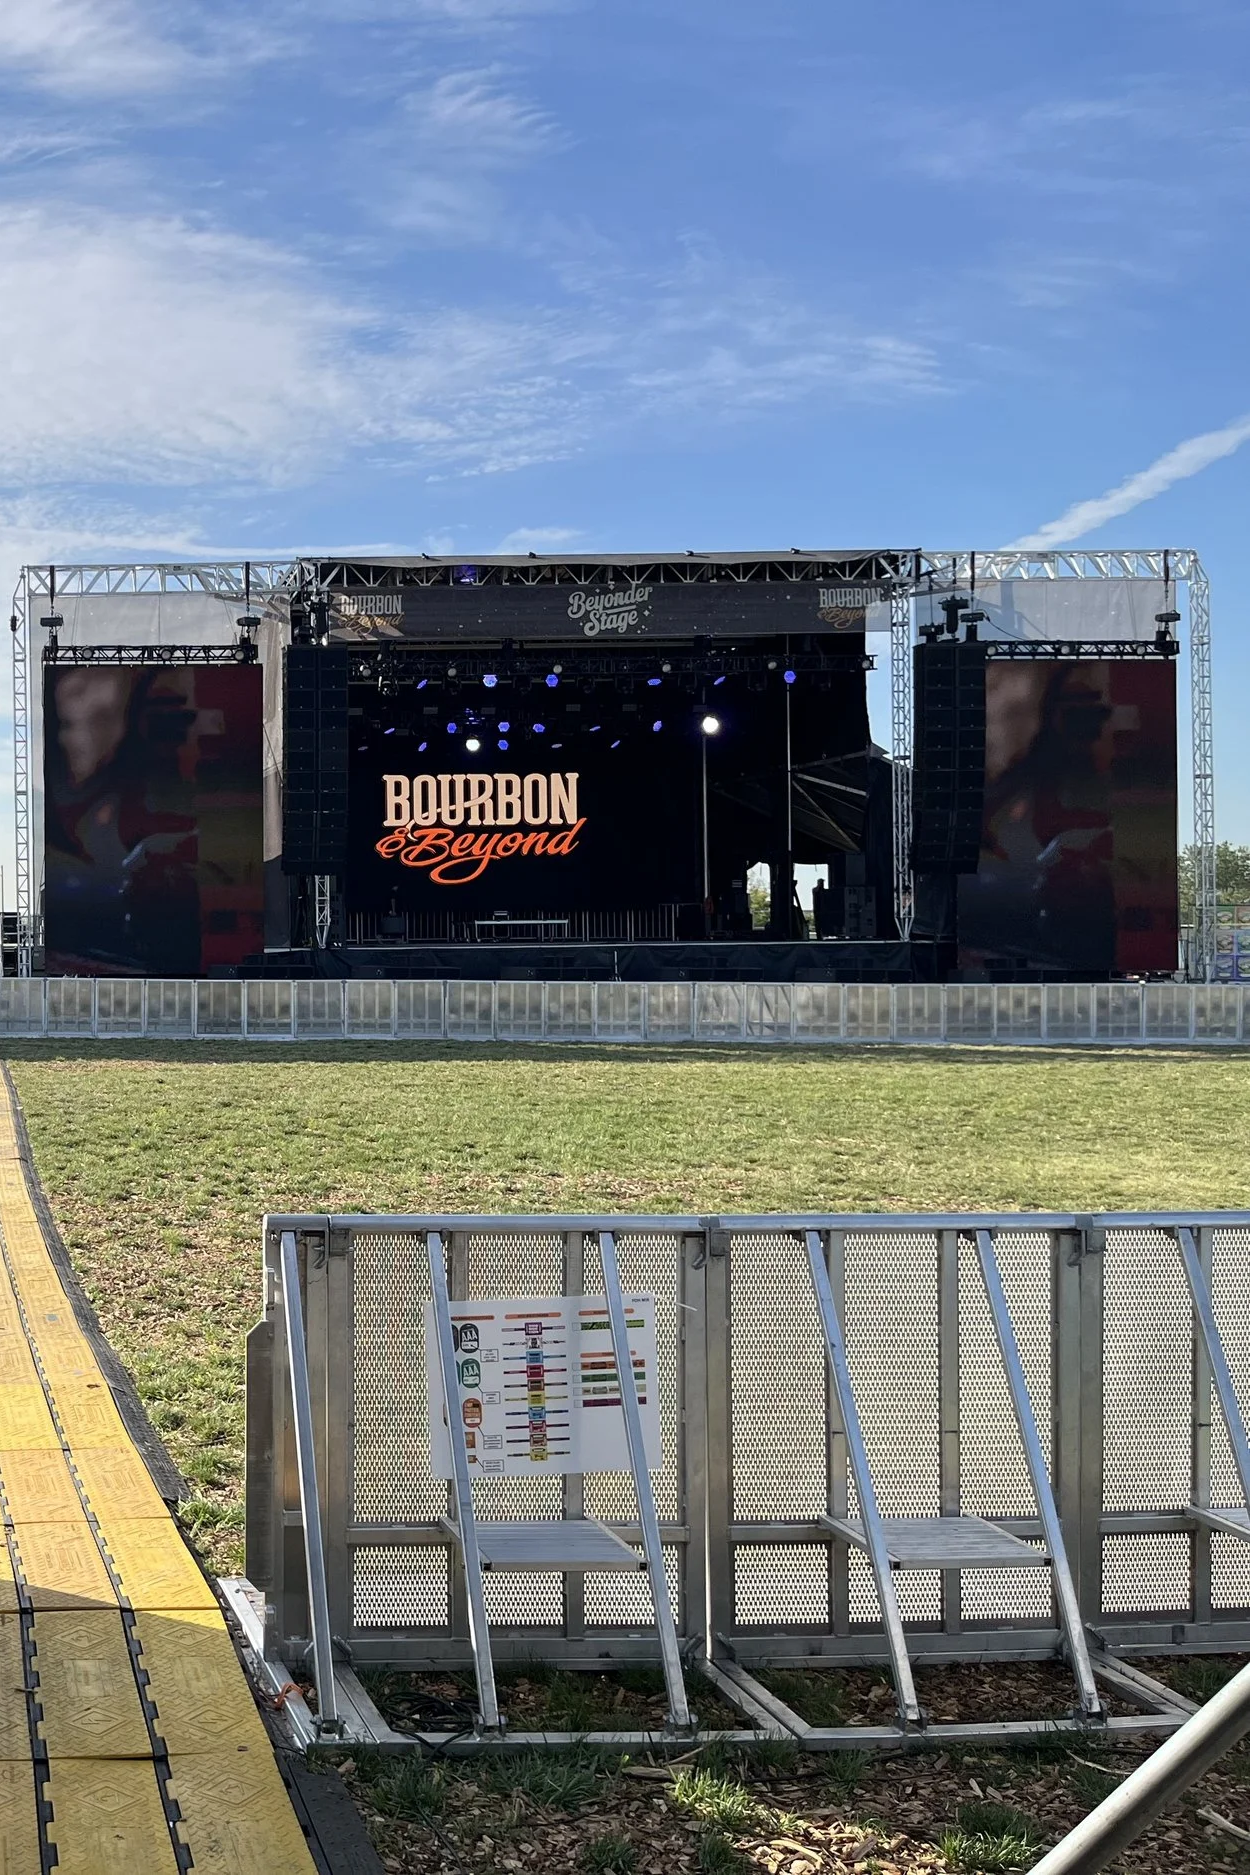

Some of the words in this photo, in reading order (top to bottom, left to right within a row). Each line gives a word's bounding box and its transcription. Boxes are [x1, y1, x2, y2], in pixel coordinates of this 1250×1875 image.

[339, 595, 402, 615] BOURBON
[567, 581, 653, 619] Beyonder
[818, 587, 882, 607] BOURBON
[583, 610, 639, 636] Stage
[382, 772, 580, 827] BOURBON
[461, 1329, 478, 1341] AAA
[463, 1363, 480, 1376] AAA
